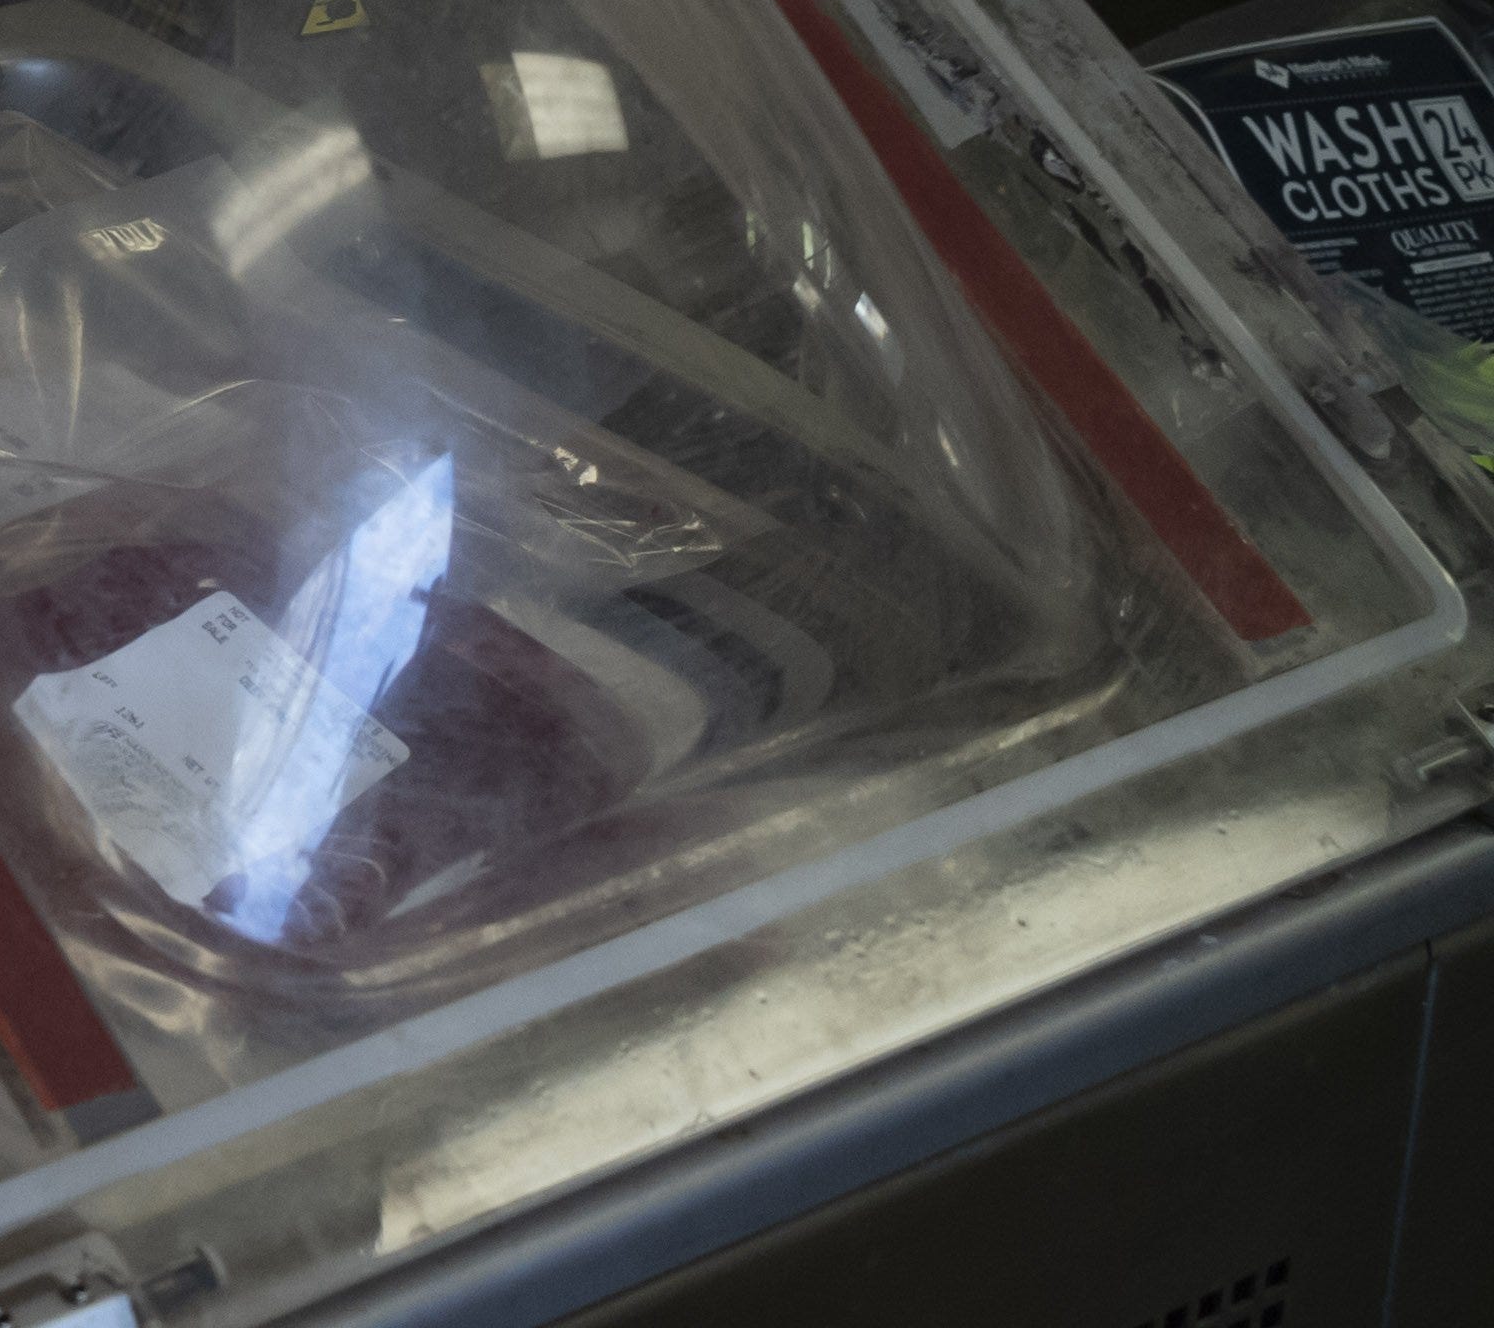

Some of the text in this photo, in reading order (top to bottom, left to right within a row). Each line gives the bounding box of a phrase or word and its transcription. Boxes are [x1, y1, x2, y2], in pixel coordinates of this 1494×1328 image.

[1242, 100, 1426, 177] WASH
[1423, 107, 1483, 160] 24
[1282, 166, 1451, 222] CLOTHS
[1451, 157, 1494, 191] PK
[1390, 219, 1480, 257] QUALITY
